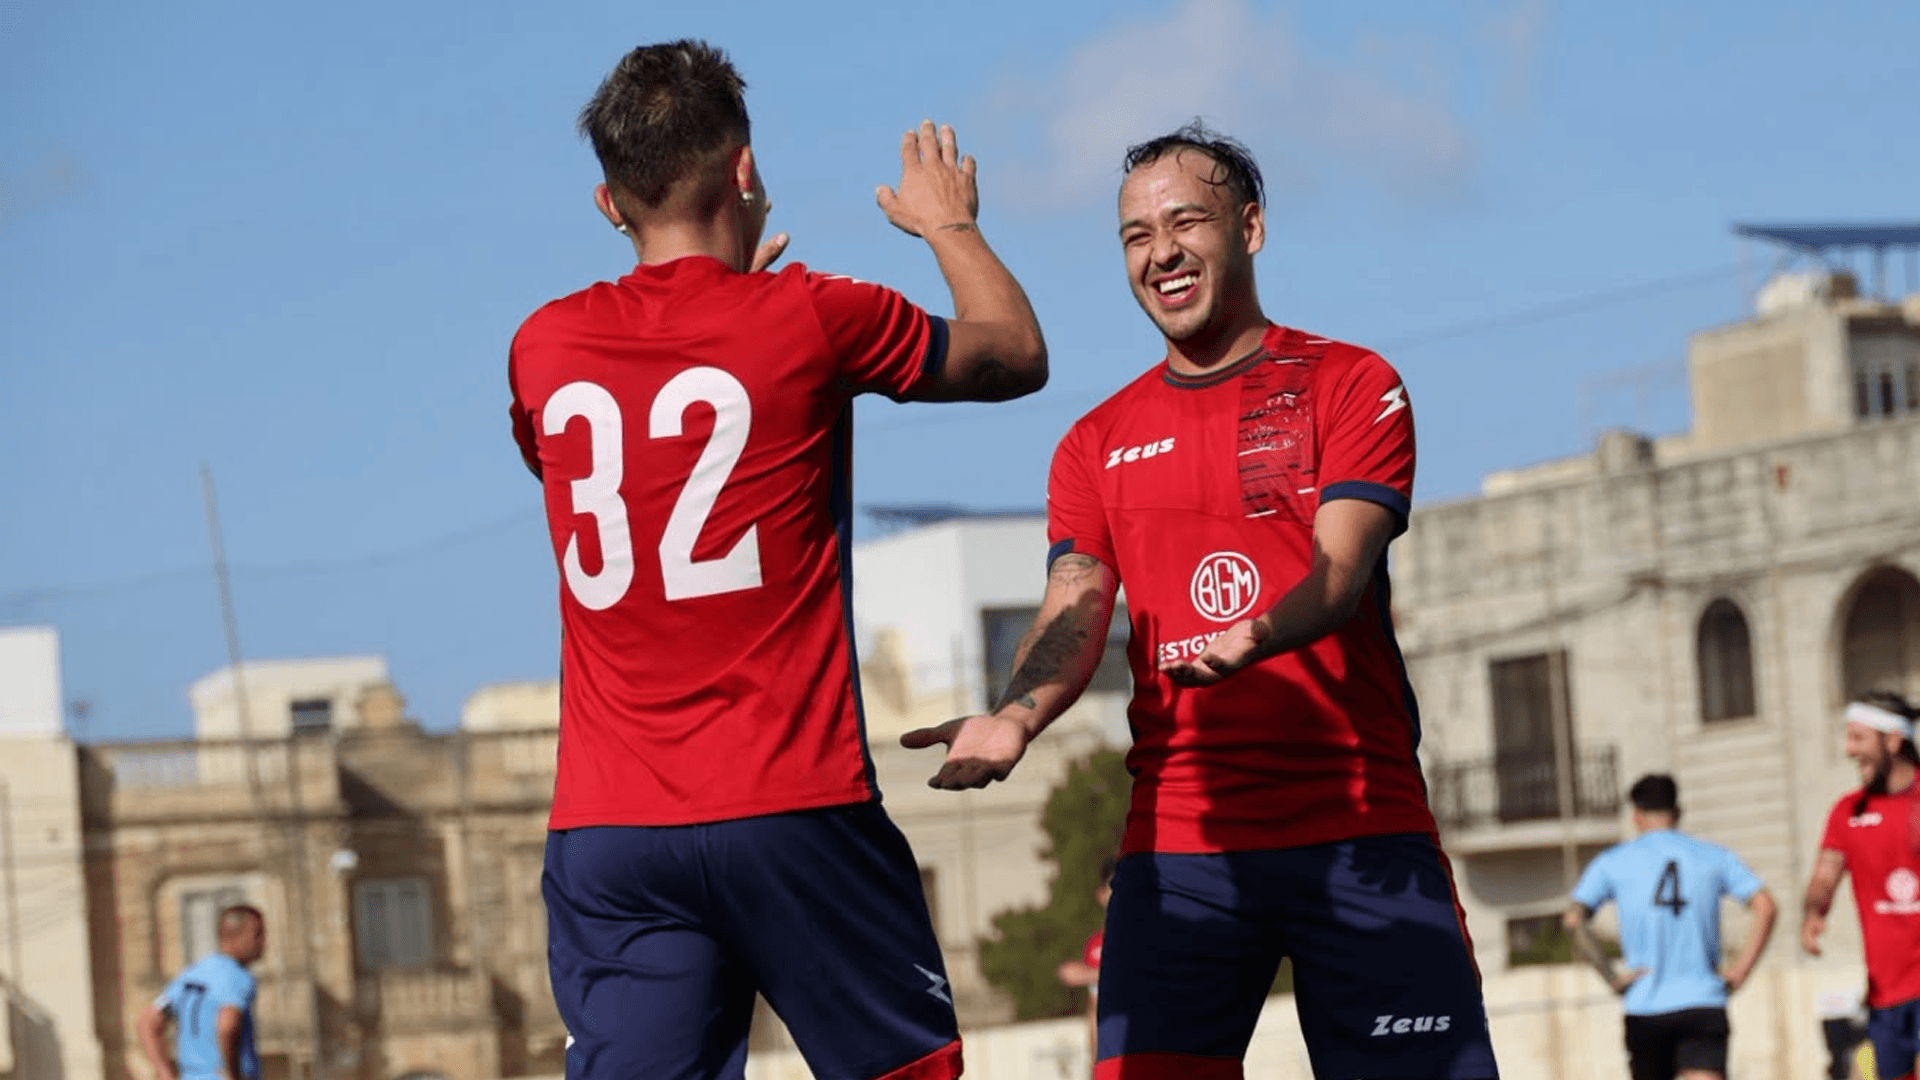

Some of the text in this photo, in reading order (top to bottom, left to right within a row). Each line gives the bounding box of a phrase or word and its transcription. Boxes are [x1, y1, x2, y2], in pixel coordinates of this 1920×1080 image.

[1105, 437, 1175, 469] Zeus
[542, 365, 764, 611] 32
[1199, 558, 1253, 617] BGM
[1652, 859, 1688, 918] 4
[184, 981, 207, 1038] 7
[1370, 1014, 1451, 1037] Zeus
